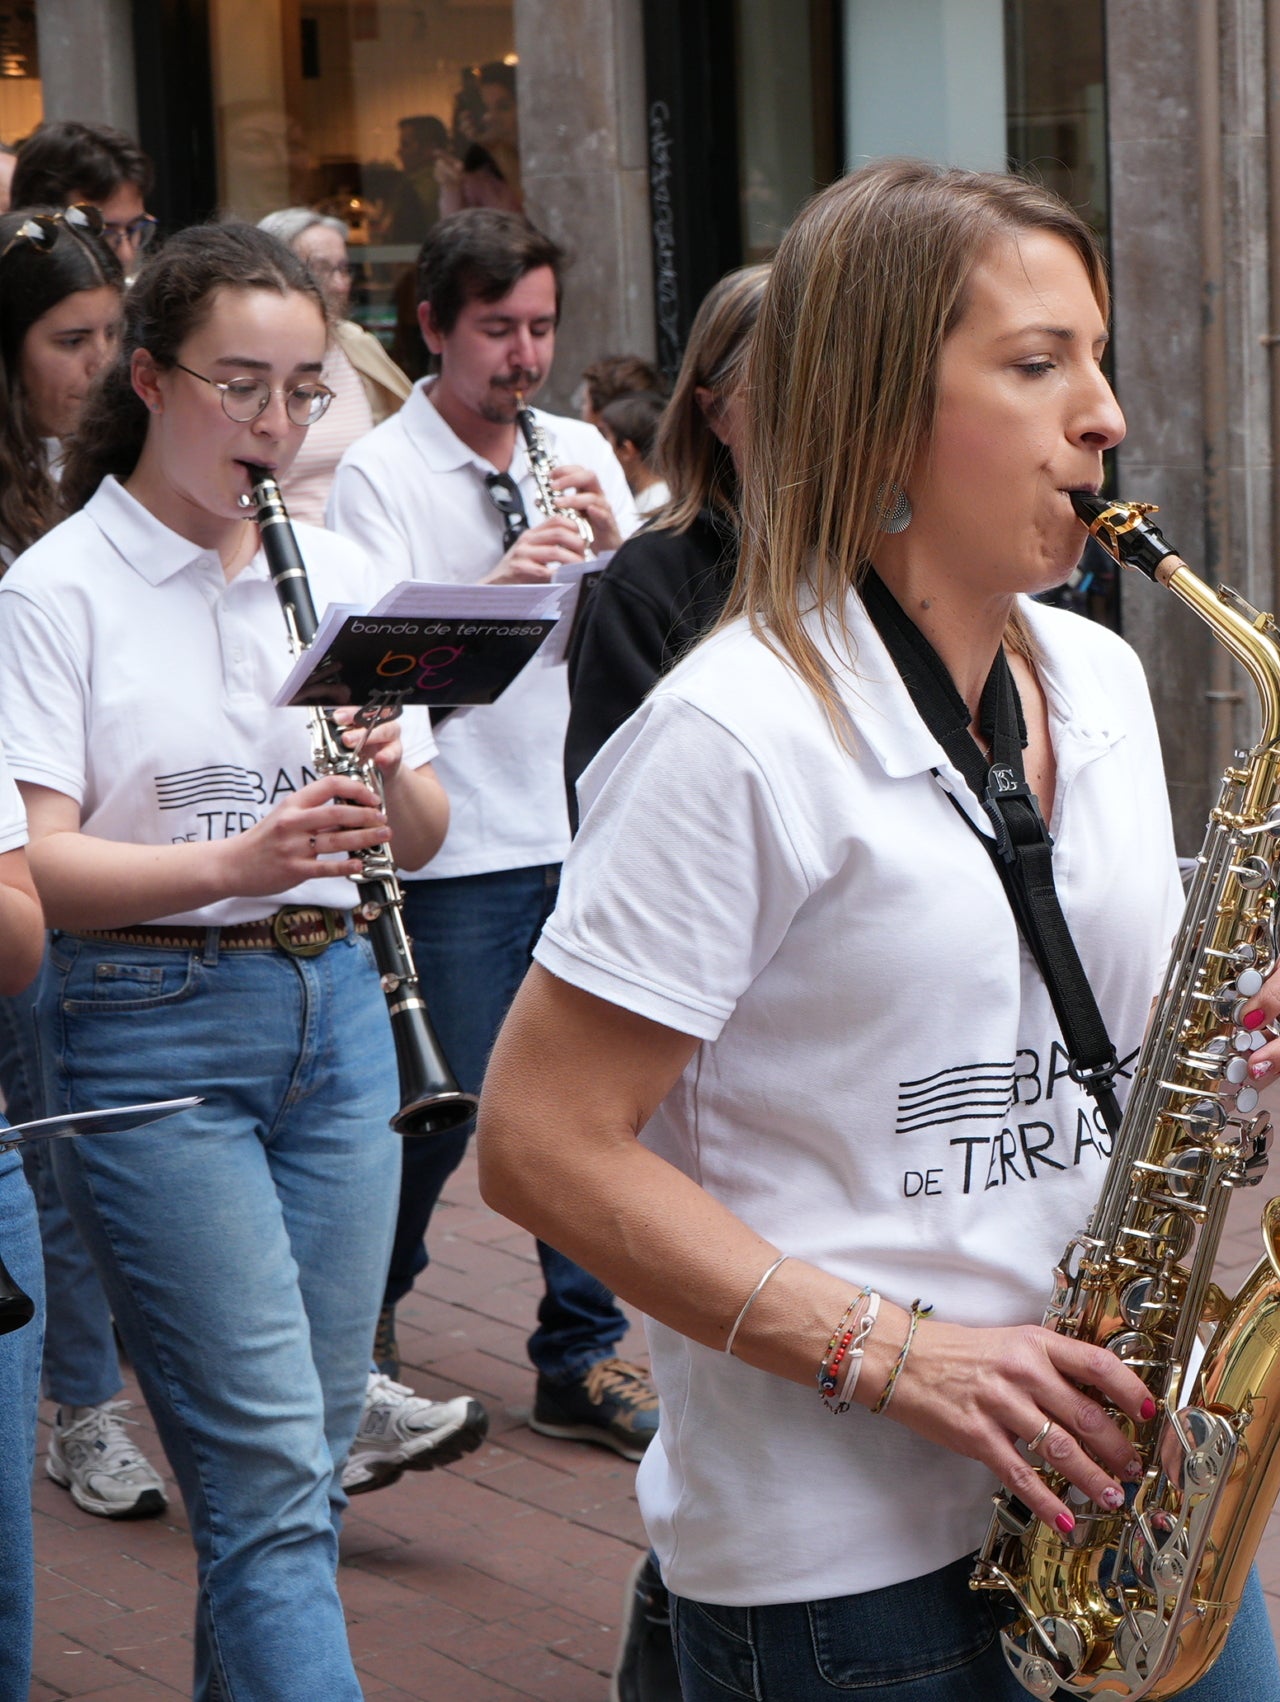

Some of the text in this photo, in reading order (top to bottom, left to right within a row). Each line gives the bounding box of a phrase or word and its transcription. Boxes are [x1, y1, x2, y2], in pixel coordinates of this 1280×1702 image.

[350, 620, 544, 637] banda de terrassa
[904, 1105, 1117, 1197] DE TERRAS
